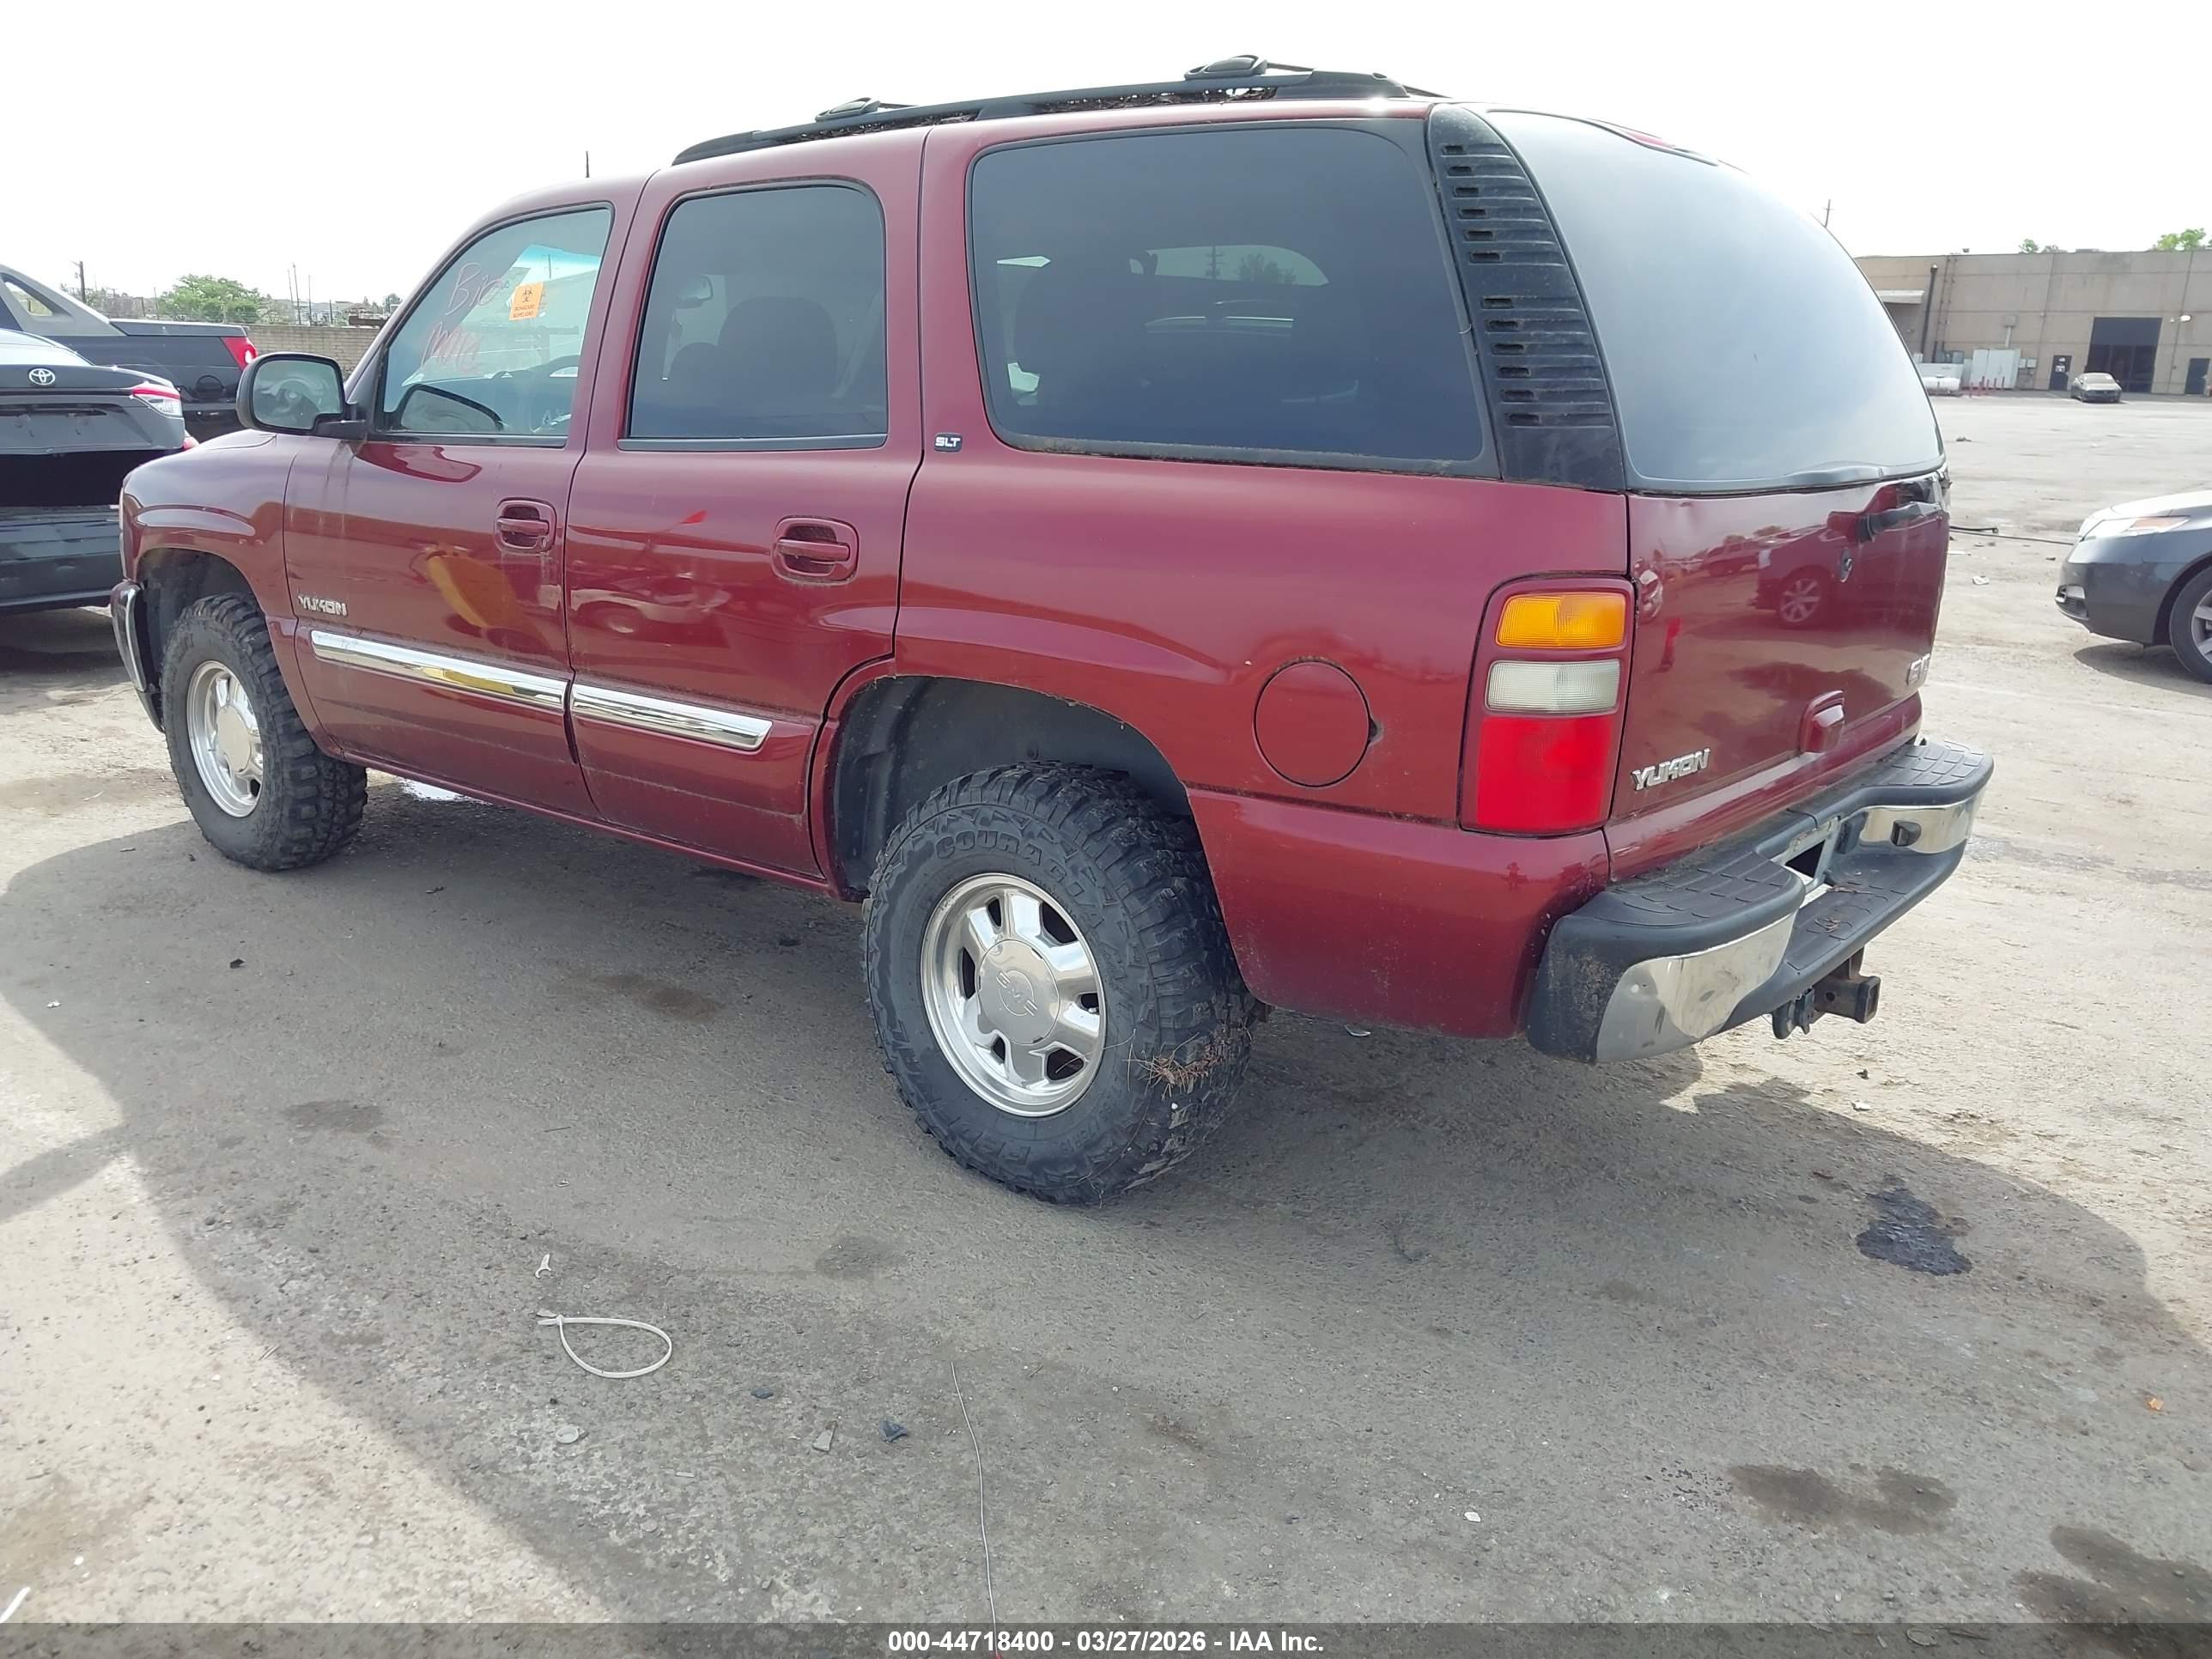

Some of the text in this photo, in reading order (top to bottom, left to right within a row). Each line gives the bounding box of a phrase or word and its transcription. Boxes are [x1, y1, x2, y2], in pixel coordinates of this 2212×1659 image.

[935, 436, 961, 447] SLT
[297, 593, 348, 617] YUKON
[1632, 747, 1711, 791] YUKON
